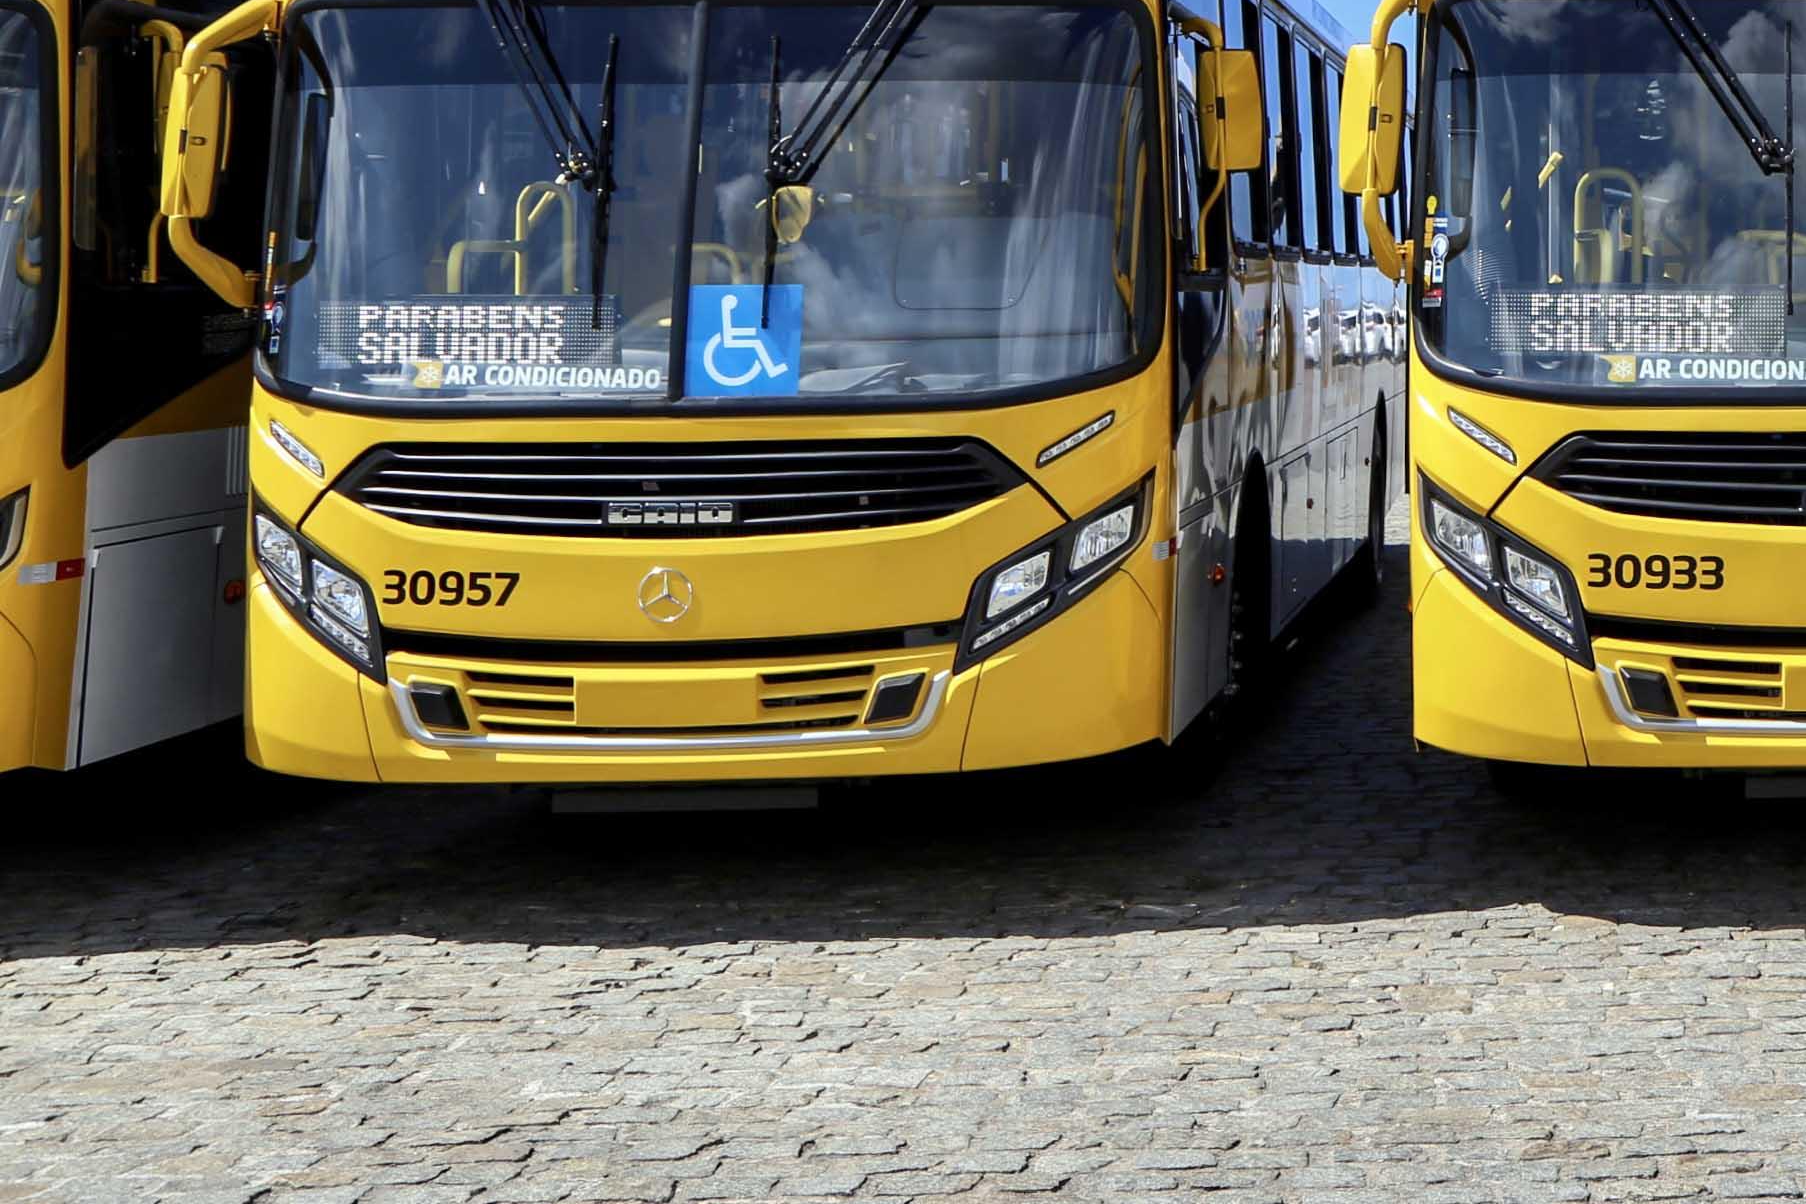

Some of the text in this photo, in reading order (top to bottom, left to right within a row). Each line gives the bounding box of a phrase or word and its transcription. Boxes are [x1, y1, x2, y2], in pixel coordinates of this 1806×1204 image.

[359, 305, 565, 329] PARABENS
[1530, 293, 1735, 318] PARABENS
[358, 331, 565, 365] SALVADOR
[1530, 319, 1735, 352] SALVADOR
[445, 364, 661, 389] AR CONDICIONADO
[1638, 359, 1671, 380] AR
[607, 502, 733, 525] CAIO
[1587, 553, 1725, 590] 30933
[382, 569, 521, 607] 30957
